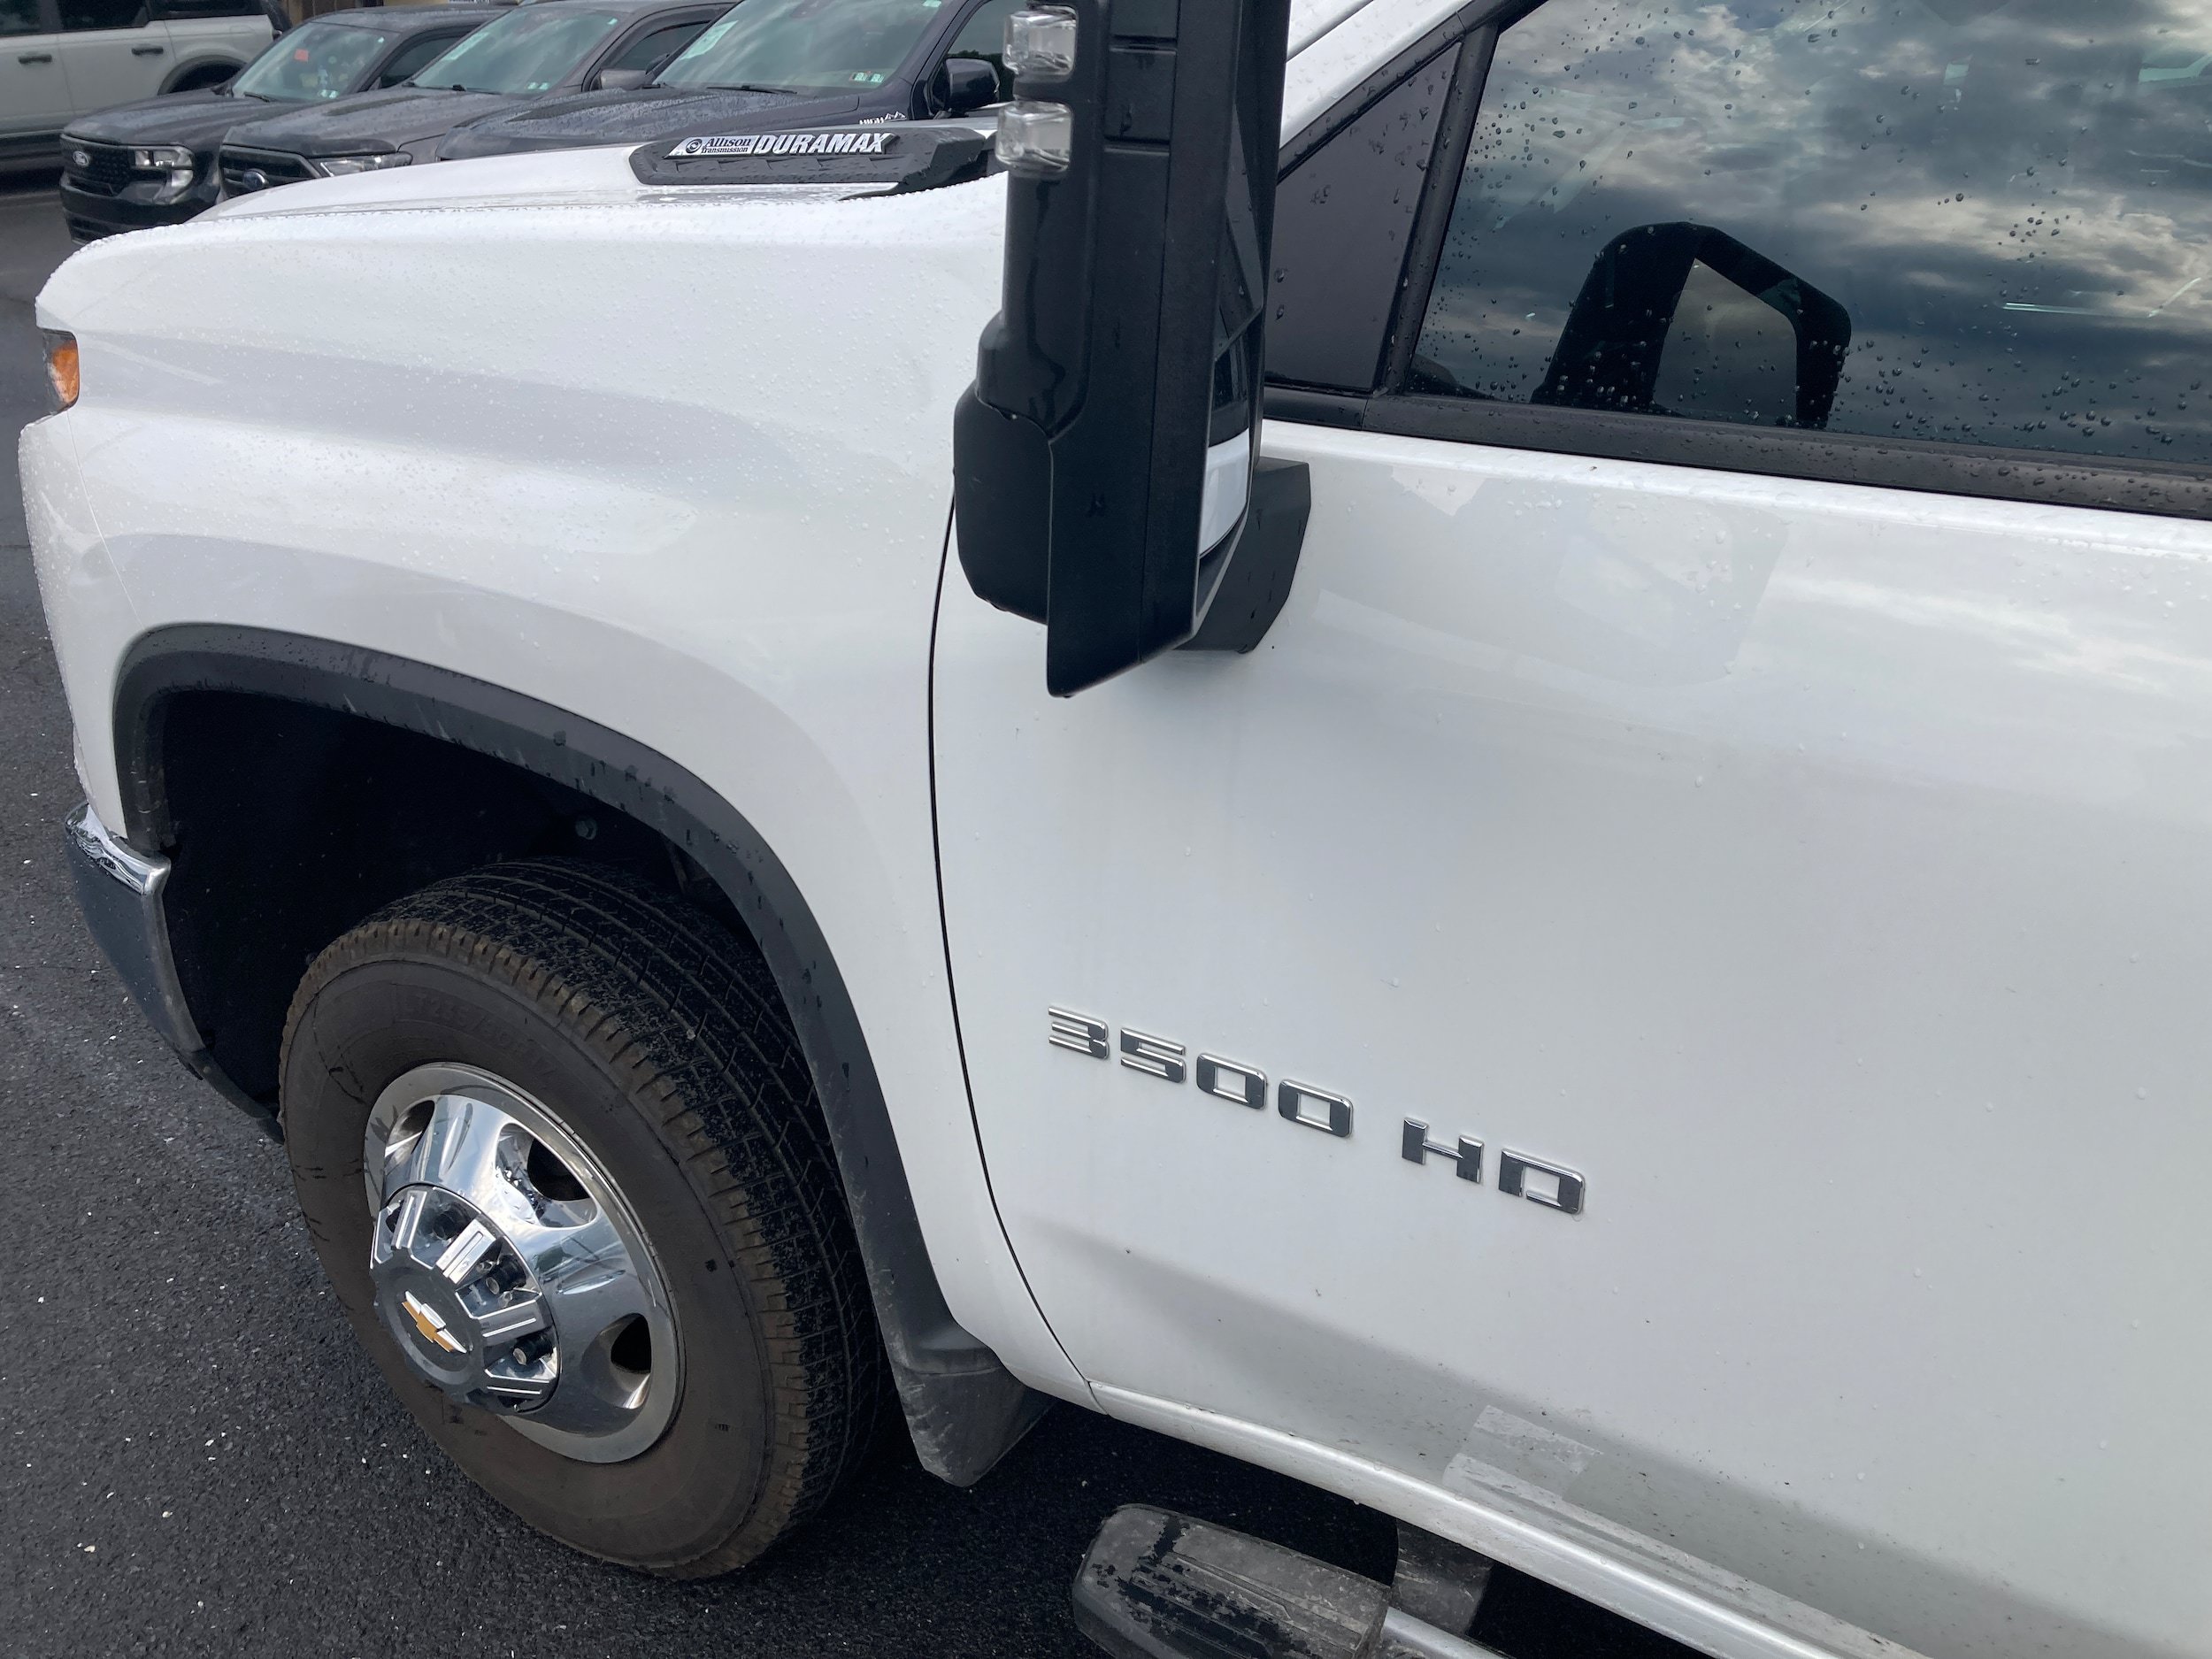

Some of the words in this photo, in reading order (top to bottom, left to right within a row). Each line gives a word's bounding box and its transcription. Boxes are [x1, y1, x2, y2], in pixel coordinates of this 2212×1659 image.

[704, 137, 751, 148] Allison
[754, 133, 895, 155] DURAMAX
[1048, 1006, 1354, 1138] 3500
[1402, 1117, 1585, 1215] HD
